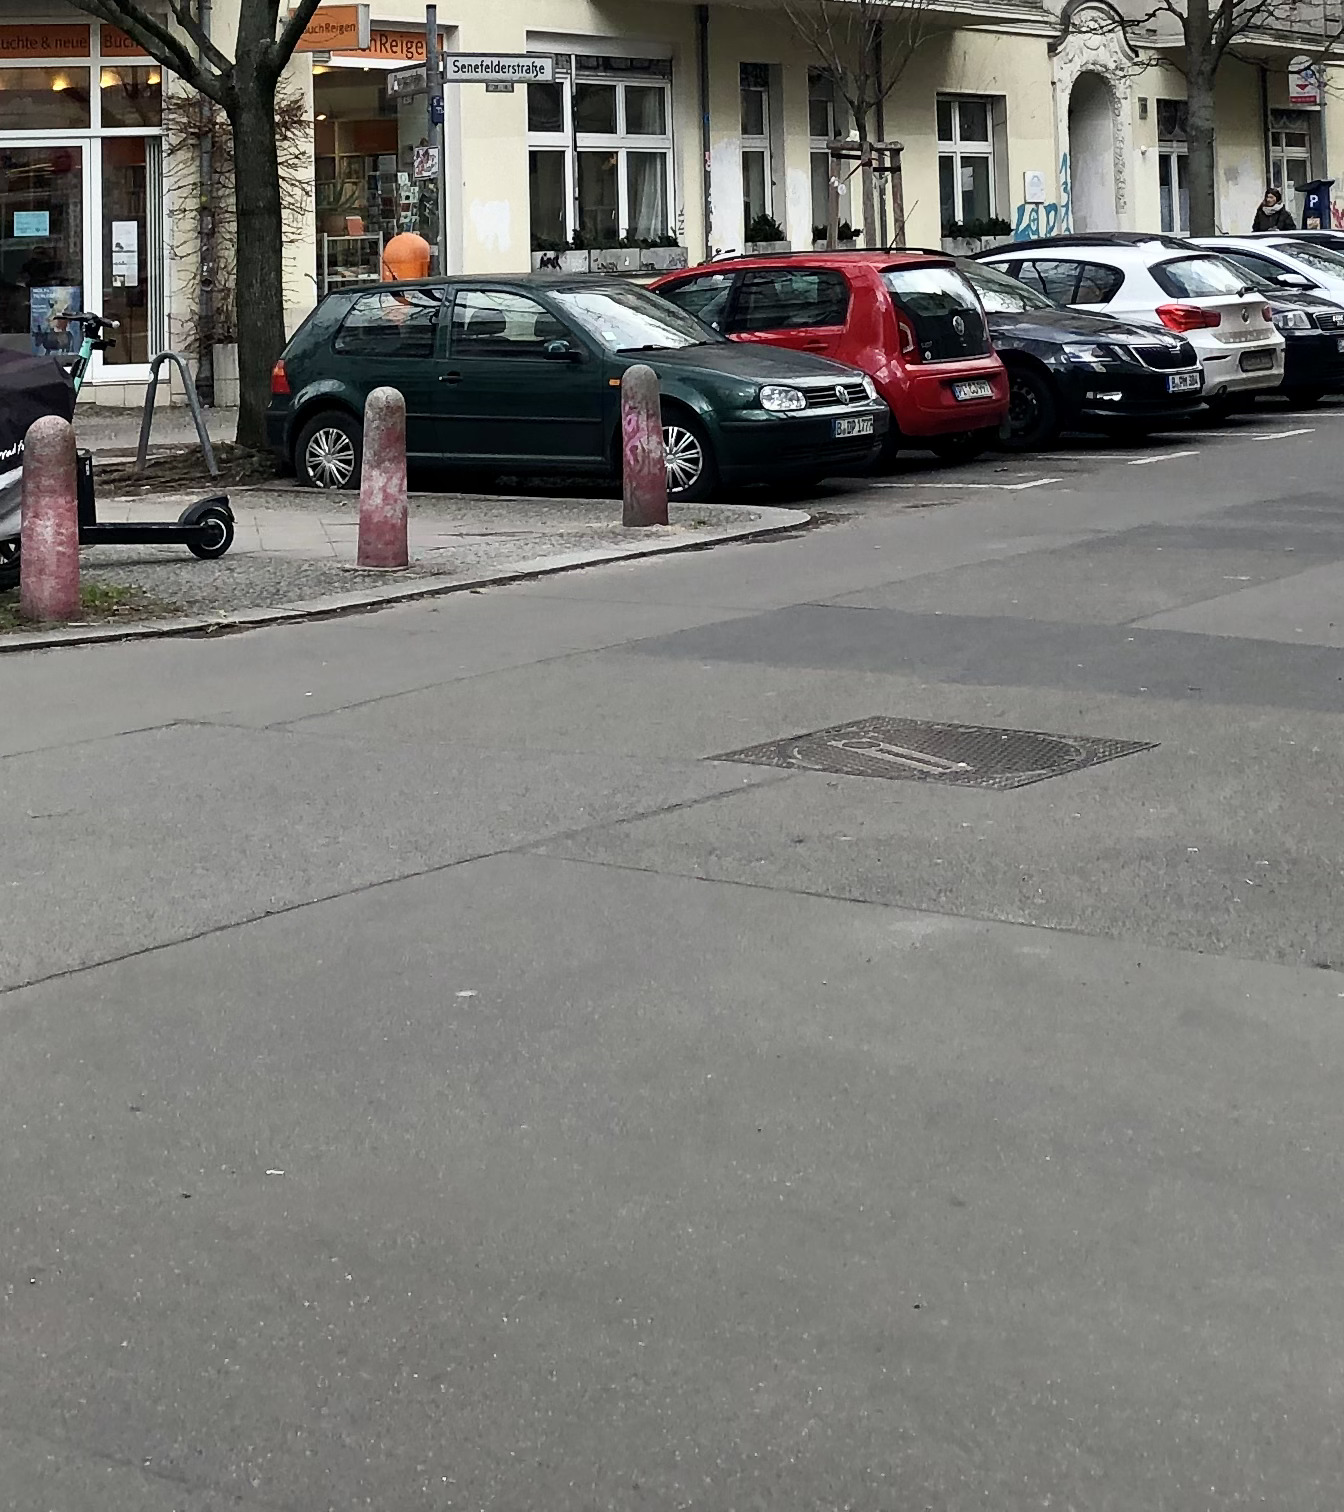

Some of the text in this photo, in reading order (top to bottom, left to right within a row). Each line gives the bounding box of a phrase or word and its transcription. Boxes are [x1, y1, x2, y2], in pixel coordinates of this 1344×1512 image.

[305, 23, 356, 35] uchReigen
[55, 37, 88, 49] neue
[452, 59, 545, 78] Senefelderstraße
